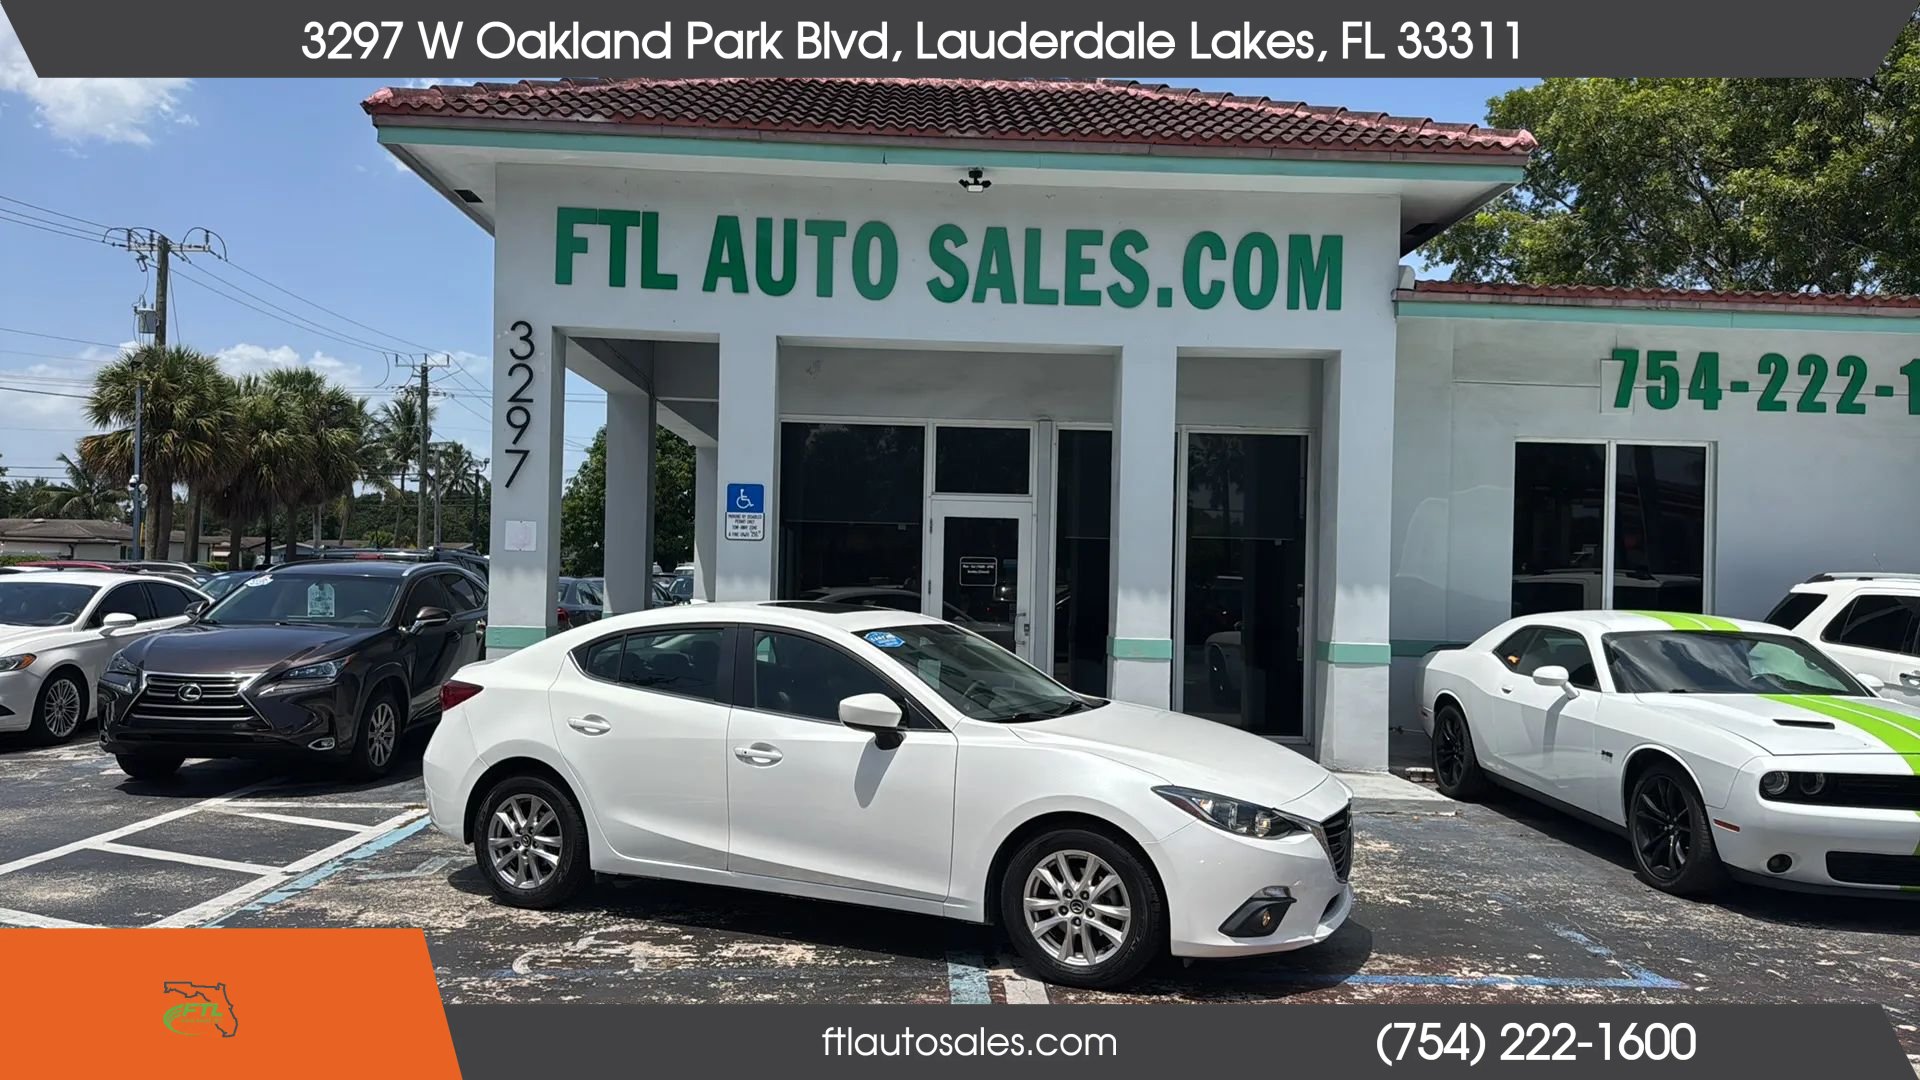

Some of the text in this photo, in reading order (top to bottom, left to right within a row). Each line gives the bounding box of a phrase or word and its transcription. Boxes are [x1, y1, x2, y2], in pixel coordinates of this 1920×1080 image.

[555, 207, 1344, 311] FTL AUTO SALES.COM
[504, 320, 536, 489] 3297
